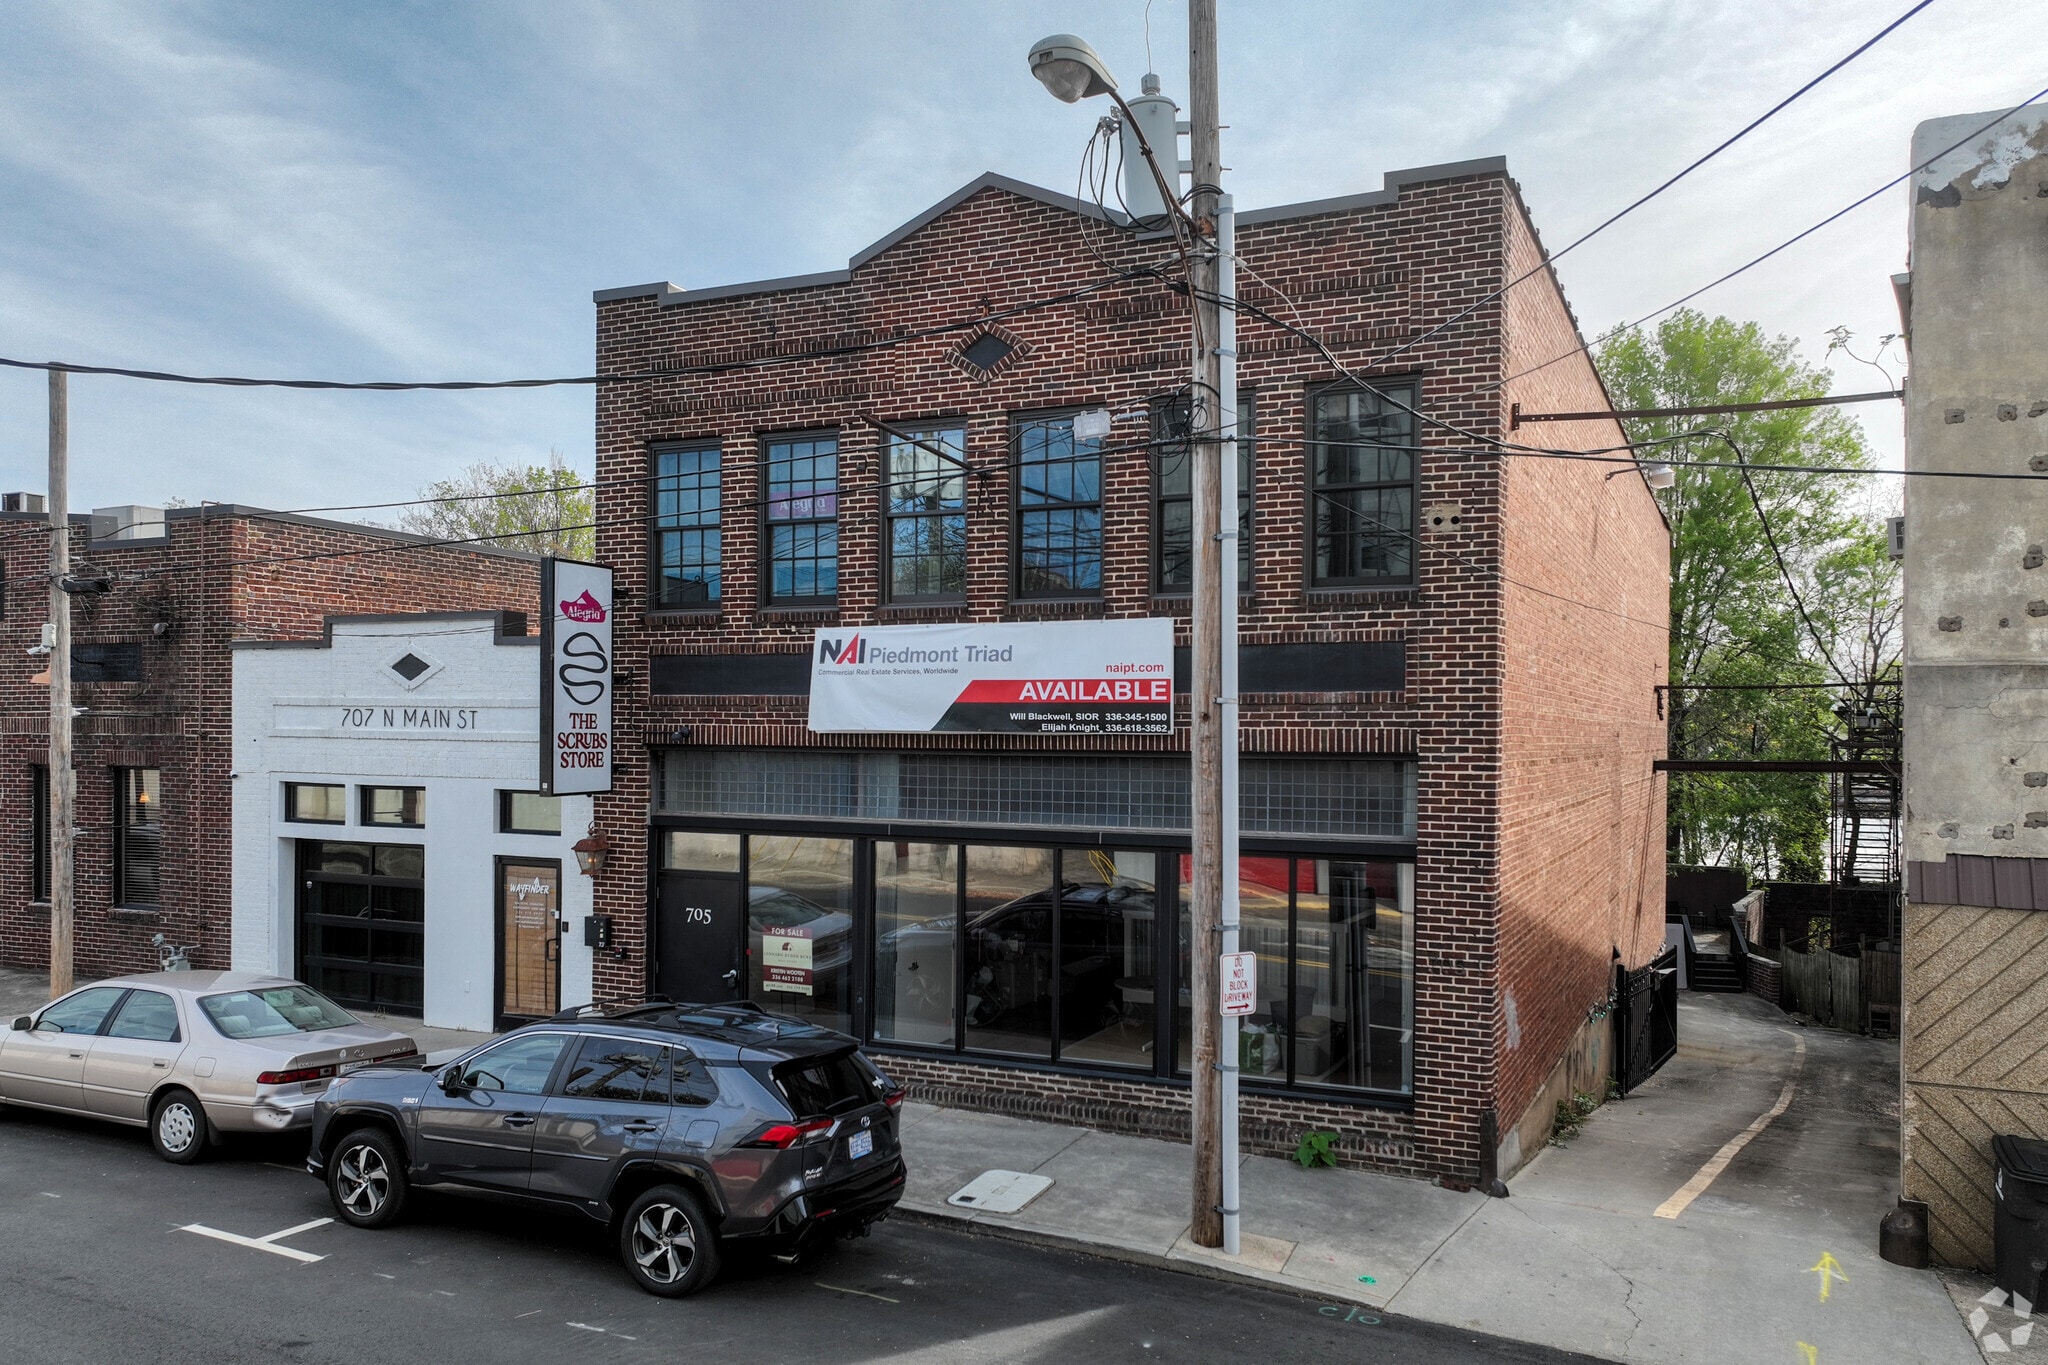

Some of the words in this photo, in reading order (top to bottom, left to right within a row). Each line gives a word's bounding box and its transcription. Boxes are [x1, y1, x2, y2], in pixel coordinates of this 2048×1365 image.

[780, 497, 825, 512] Aegra
[819, 632, 866, 664] NAI
[869, 647, 959, 663] Piedmont
[965, 645, 1013, 662] Triad
[818, 668, 855, 676] Commercial
[856, 668, 870, 676] Real
[892, 667, 922, 676] Services,
[1105, 663, 1164, 675] naipt.com
[1019, 681, 1167, 700] AVAILABLE
[341, 708, 374, 727] 707
[383, 709, 394, 727] N
[403, 709, 450, 728] MAIN
[457, 710, 478, 729] ST
[569, 712, 598, 729] THE
[1009, 712, 1026, 721] Will
[1028, 712, 1073, 722] Blackwell,
[1075, 713, 1099, 721] SIOR
[1105, 713, 1168, 721] 336-345-1500
[1042, 723, 1067, 733] Elijah
[1069, 723, 1100, 732] Knight
[1105, 724, 1168, 732] 336-618-3562
[557, 732, 608, 749] SCRUBS
[560, 751, 604, 768] STORE
[510, 880, 549, 897] WAYFINDER
[685, 907, 712, 924] 705
[771, 927, 785, 936] FOR
[787, 928, 804, 937] SALE
[1234, 957, 1242, 967] DO
[1233, 968, 1244, 978] NOT
[1229, 980, 1248, 990] BLOCK
[1224, 991, 1253, 1003] DRIVEWAY
